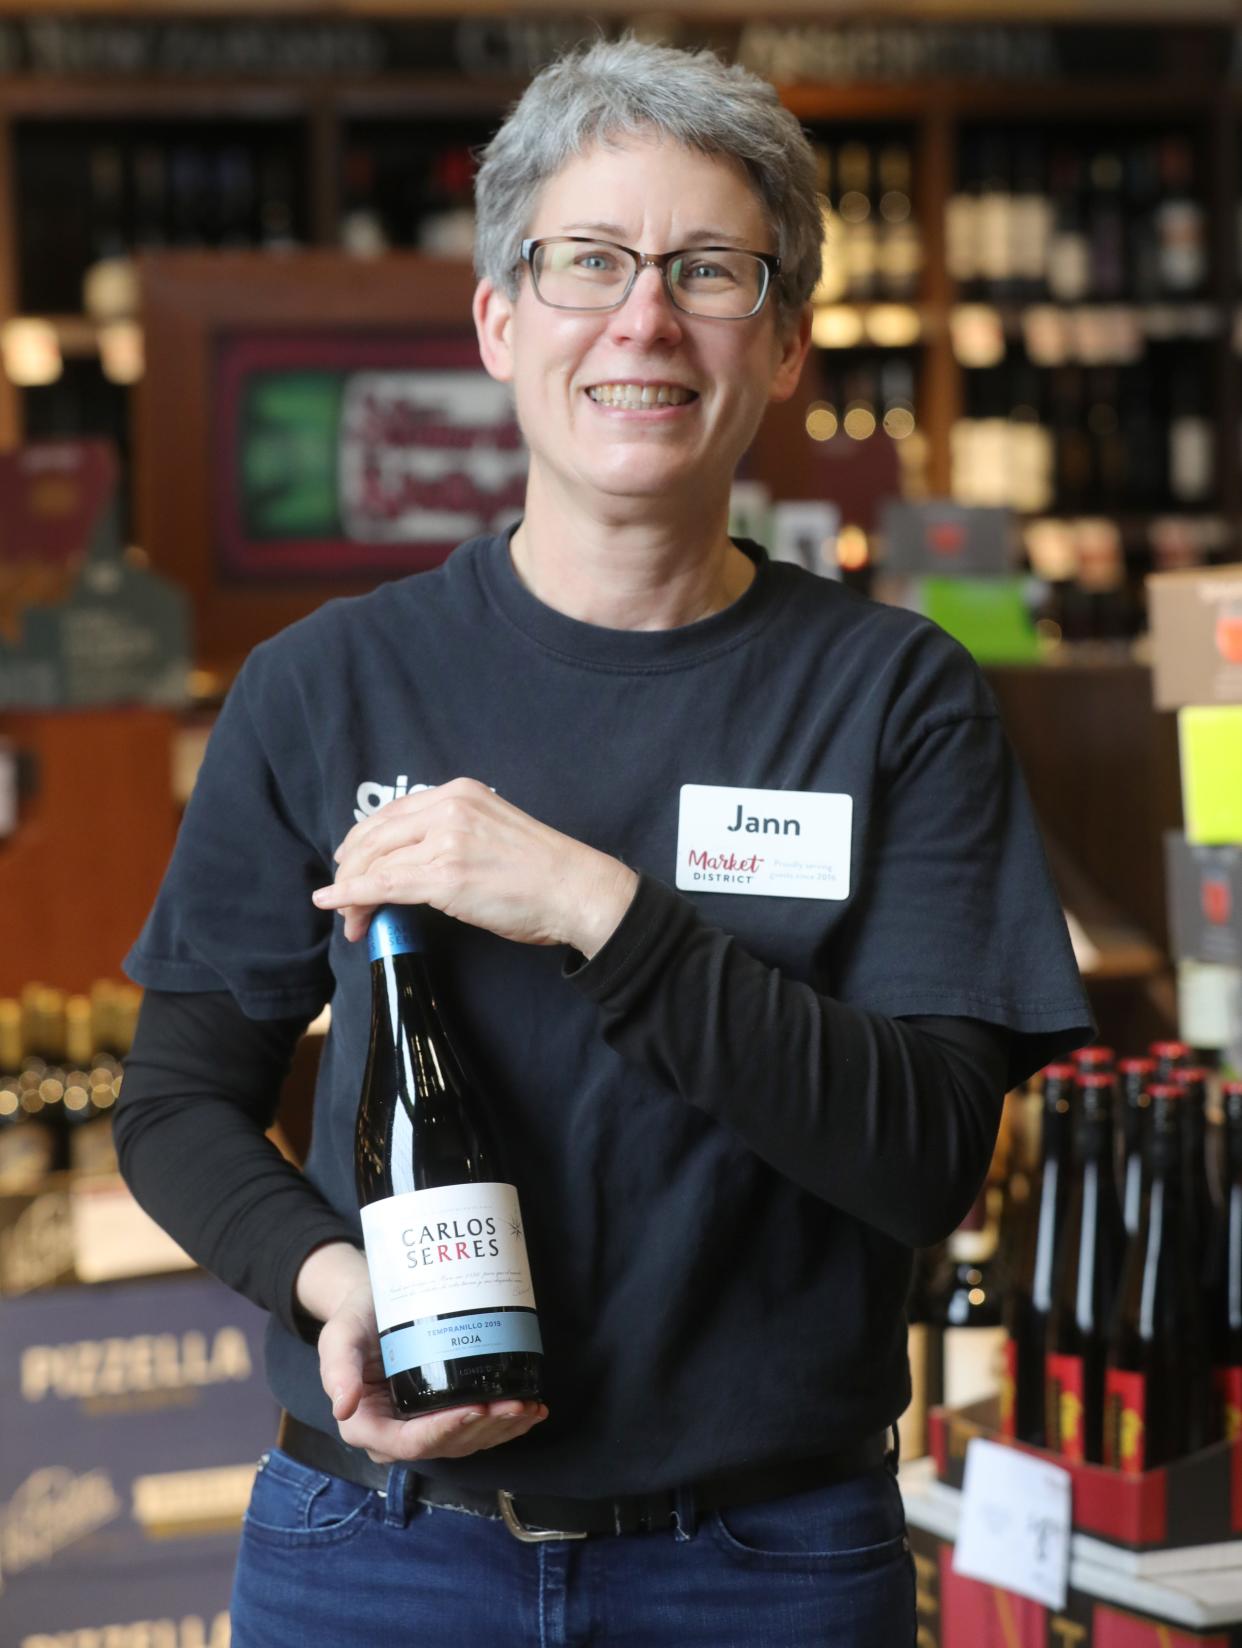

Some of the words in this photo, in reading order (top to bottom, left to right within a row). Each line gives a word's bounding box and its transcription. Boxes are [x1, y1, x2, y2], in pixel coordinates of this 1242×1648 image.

[727, 804, 801, 836] Jann
[688, 848, 765, 874] Market
[693, 872, 753, 884] DISTRICT
[402, 1217, 496, 1247] CARLOS
[407, 1238, 499, 1269] SERRES
[426, 1321, 483, 1337] TEMPRANILLO
[451, 1334, 482, 1347] RIOJA
